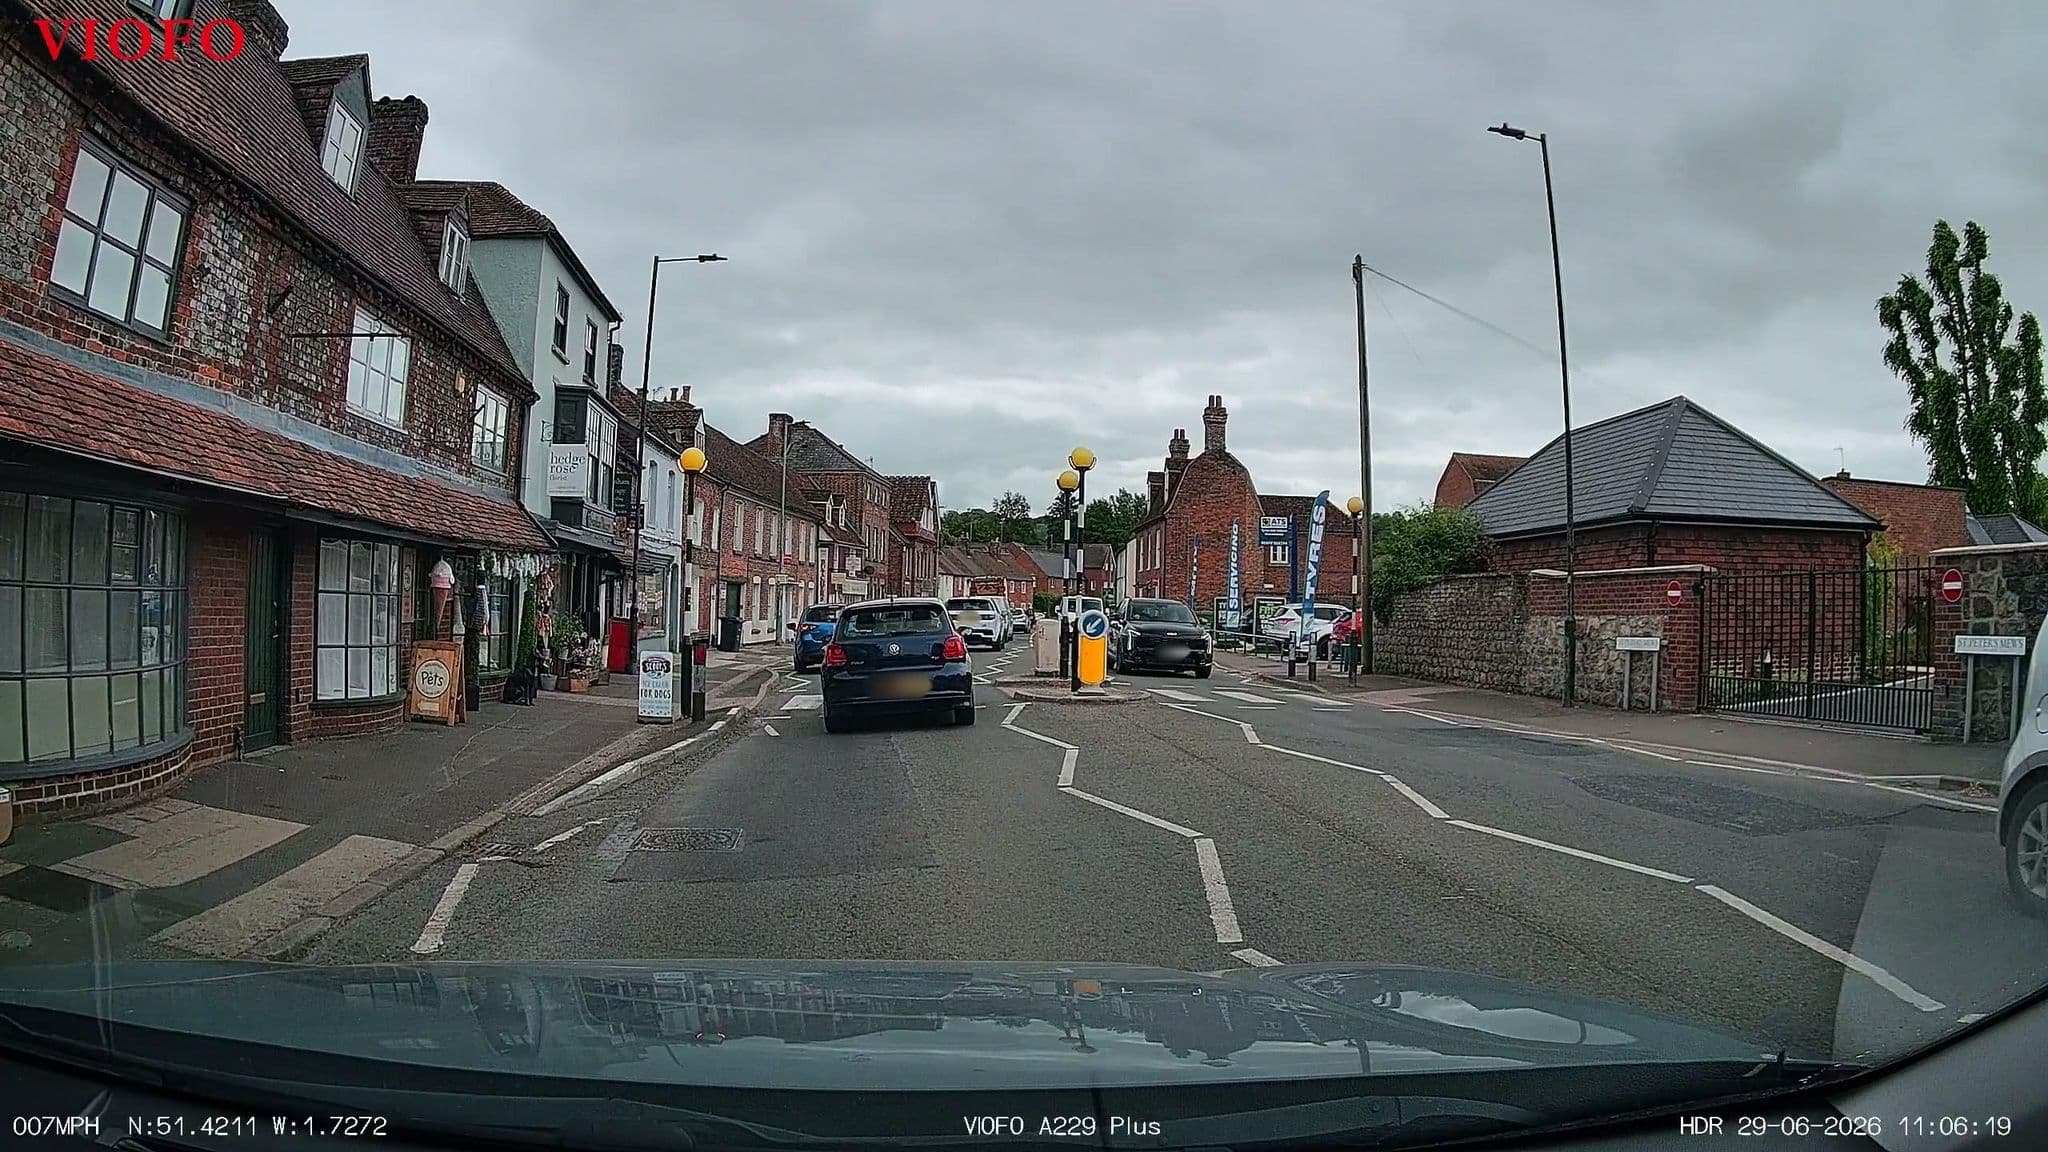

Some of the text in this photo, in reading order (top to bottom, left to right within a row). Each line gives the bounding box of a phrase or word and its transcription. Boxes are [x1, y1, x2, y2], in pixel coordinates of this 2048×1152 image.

[551, 452, 585, 466] hedge
[550, 464, 576, 473] rose
[1305, 505, 1326, 600] TYRES
[1230, 524, 1238, 609] SERVICING
[421, 671, 443, 686] Pets
[641, 688, 671, 699] FOR DOGS
